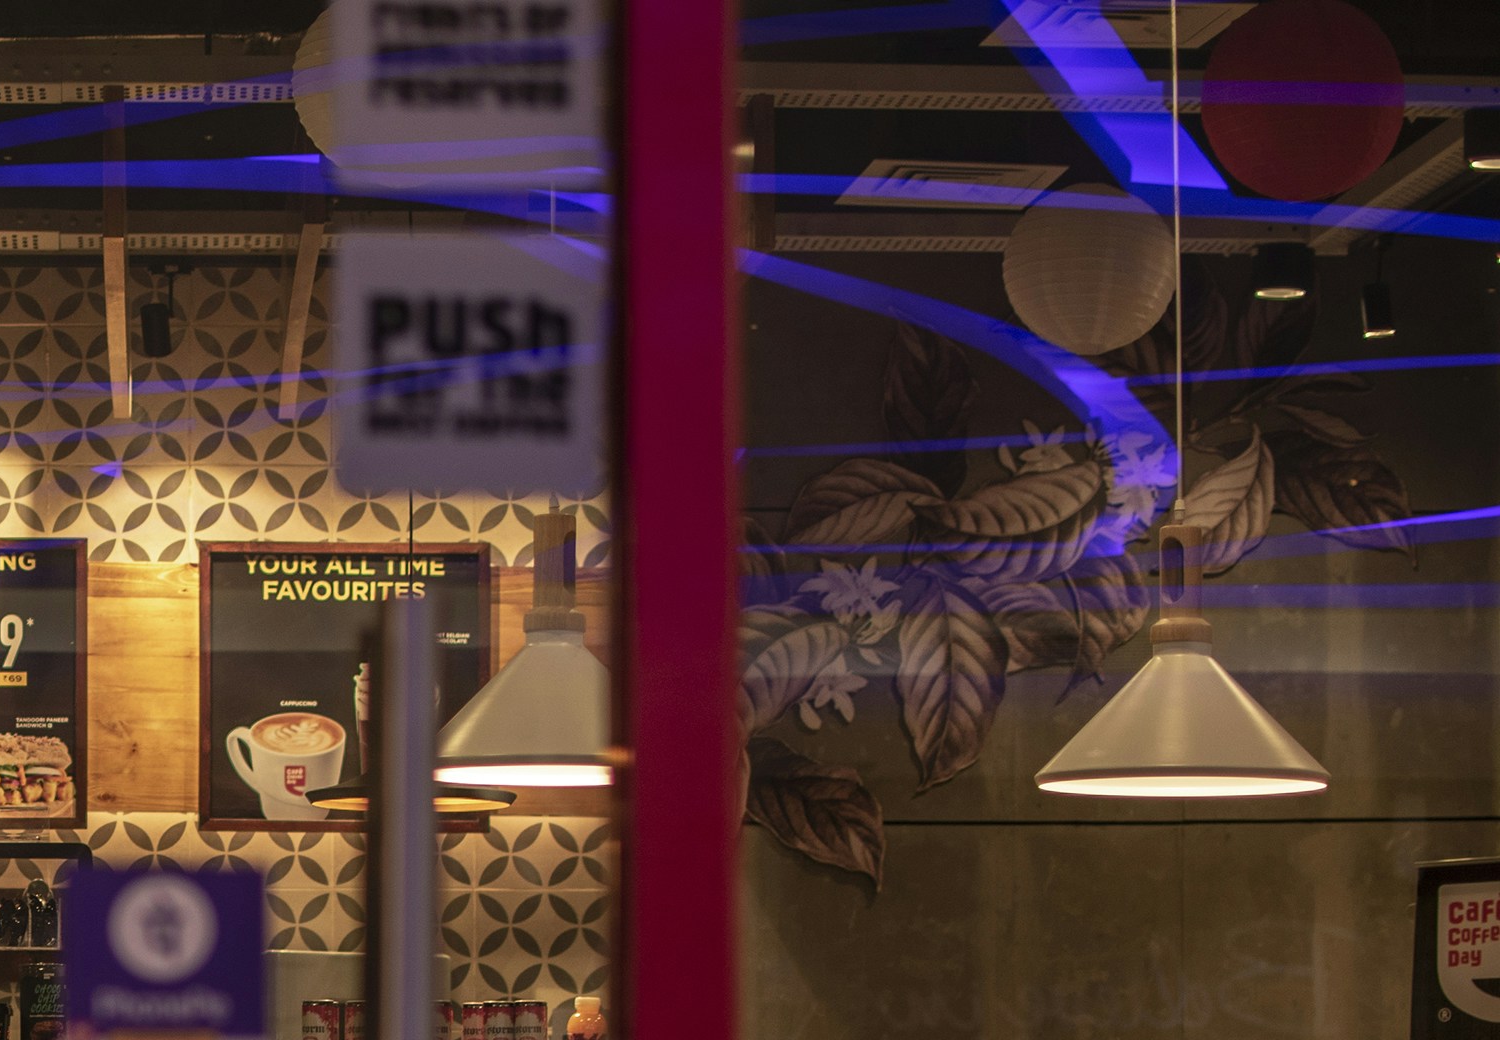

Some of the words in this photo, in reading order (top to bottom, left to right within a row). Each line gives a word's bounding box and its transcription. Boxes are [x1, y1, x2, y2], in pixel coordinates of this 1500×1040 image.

[246, 556, 317, 575] YOUR
[325, 556, 376, 575] ALL
[381, 556, 446, 576] TIME
[262, 581, 426, 601] FAVOURITES
[1448, 950, 1482, 967] Day
